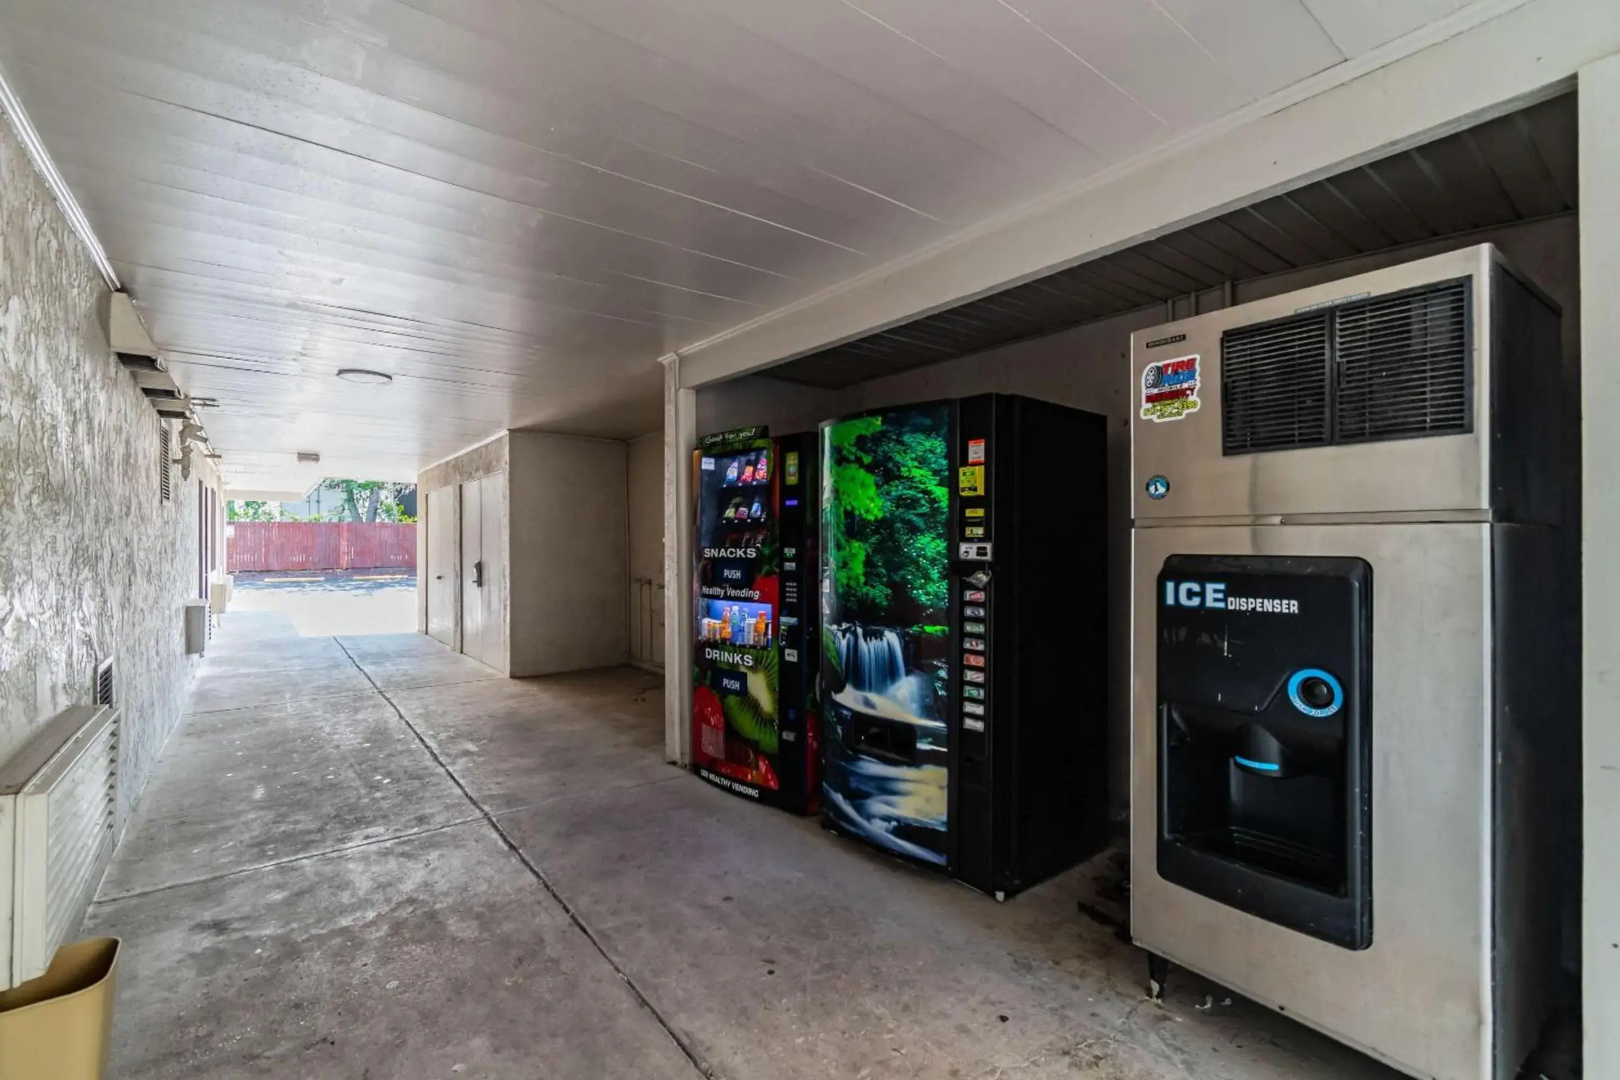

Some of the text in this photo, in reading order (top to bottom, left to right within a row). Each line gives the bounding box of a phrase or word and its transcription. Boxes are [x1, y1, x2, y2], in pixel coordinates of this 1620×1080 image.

[704, 548, 757, 559] SNACKS
[723, 569, 741, 579] PUSH
[701, 585, 760, 600] Healthy Vending
[1165, 581, 1299, 614] ICE DISPENSER
[705, 647, 754, 667] DRINKS
[722, 678, 740, 691] PUSH
[709, 772, 731, 788] HEALTHY
[731, 781, 759, 797] VENDING
